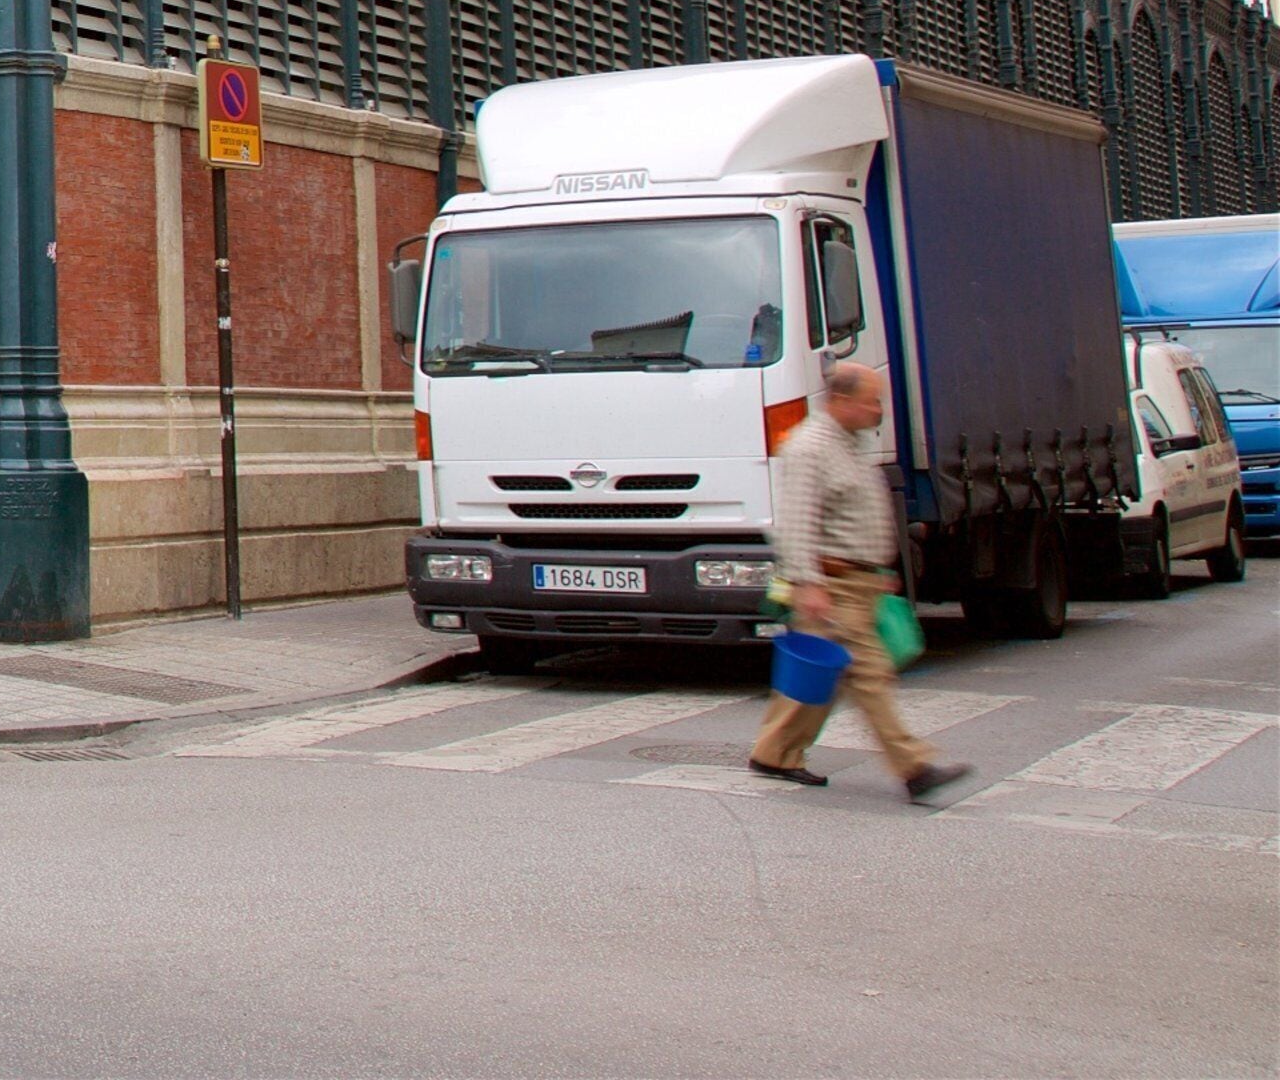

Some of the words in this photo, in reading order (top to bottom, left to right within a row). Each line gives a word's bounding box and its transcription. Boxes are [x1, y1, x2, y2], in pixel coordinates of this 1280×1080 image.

[556, 173, 646, 195] NISSAN
[550, 569, 596, 588] 1684
[602, 570, 640, 589] DSR
